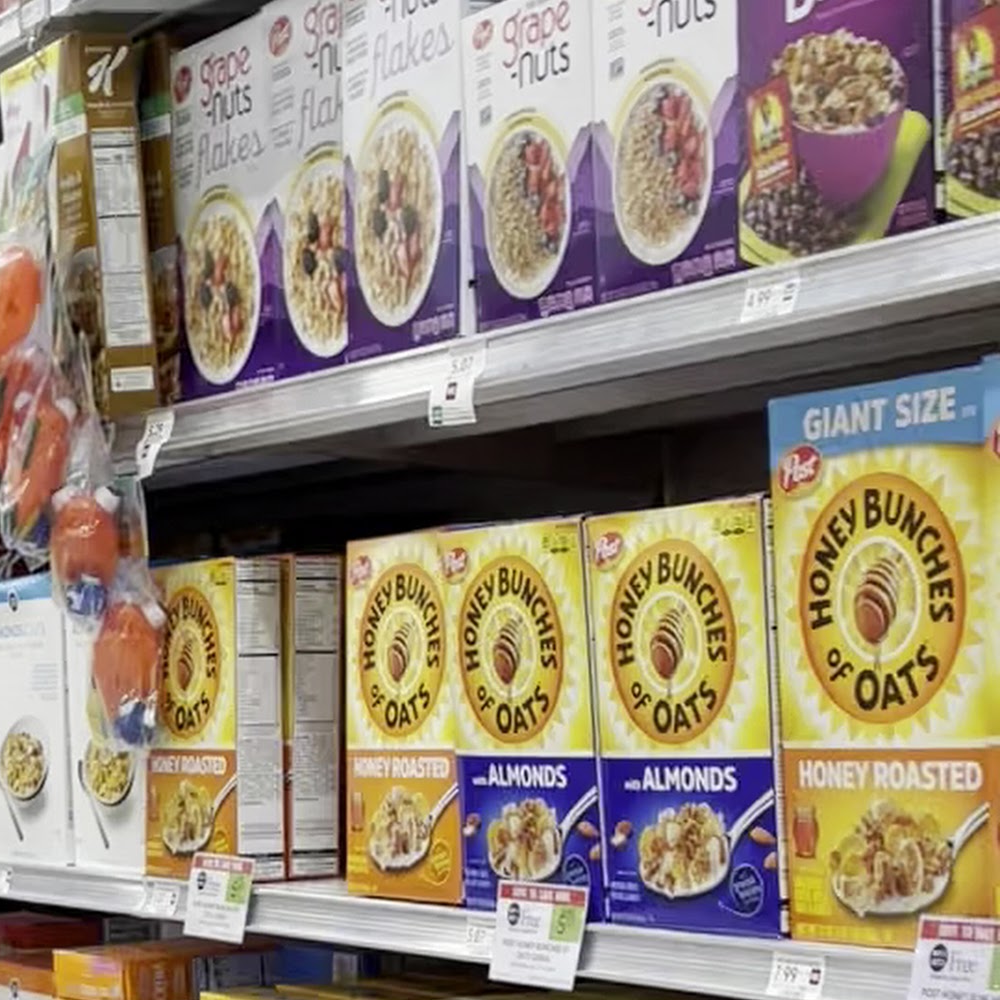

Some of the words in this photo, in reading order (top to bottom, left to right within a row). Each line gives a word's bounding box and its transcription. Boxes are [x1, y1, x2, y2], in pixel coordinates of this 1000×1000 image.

[304, 0, 342, 58] gra
[503, 1, 570, 69] grape
[200, 45, 251, 108] grape
[371, 20, 454, 98] flakes
[197, 123, 266, 188] flakes
[803, 398, 888, 441] GIANT
[894, 386, 957, 429] SIZE
[809, 498, 857, 630] HONEY
[863, 488, 955, 623] BUNCHES
[363, 578, 393, 671] HONEY
[394, 573, 441, 669] BUNCHES
[464, 573, 496, 672] HONEY
[498, 567, 558, 670] BUNCHES
[616, 560, 652, 667] HONEY
[658, 551, 728, 663] BUNCHES
[384, 684, 431, 729] OATS
[827, 648, 854, 682] OF
[854, 644, 940, 711] OATS
[175, 691, 211, 731] OATS
[477, 685, 495, 712] OF
[496, 685, 549, 734] OATS
[631, 682, 652, 710] OF
[653, 680, 718, 734] OATS
[353, 756, 390, 779] HONEY
[391, 756, 450, 779] ROASTED
[488, 763, 568, 789] ALMONDS
[642, 766, 739, 792] ALMONDS
[799, 759, 869, 789] HONEY
[873, 760, 984, 792] ROASTED
